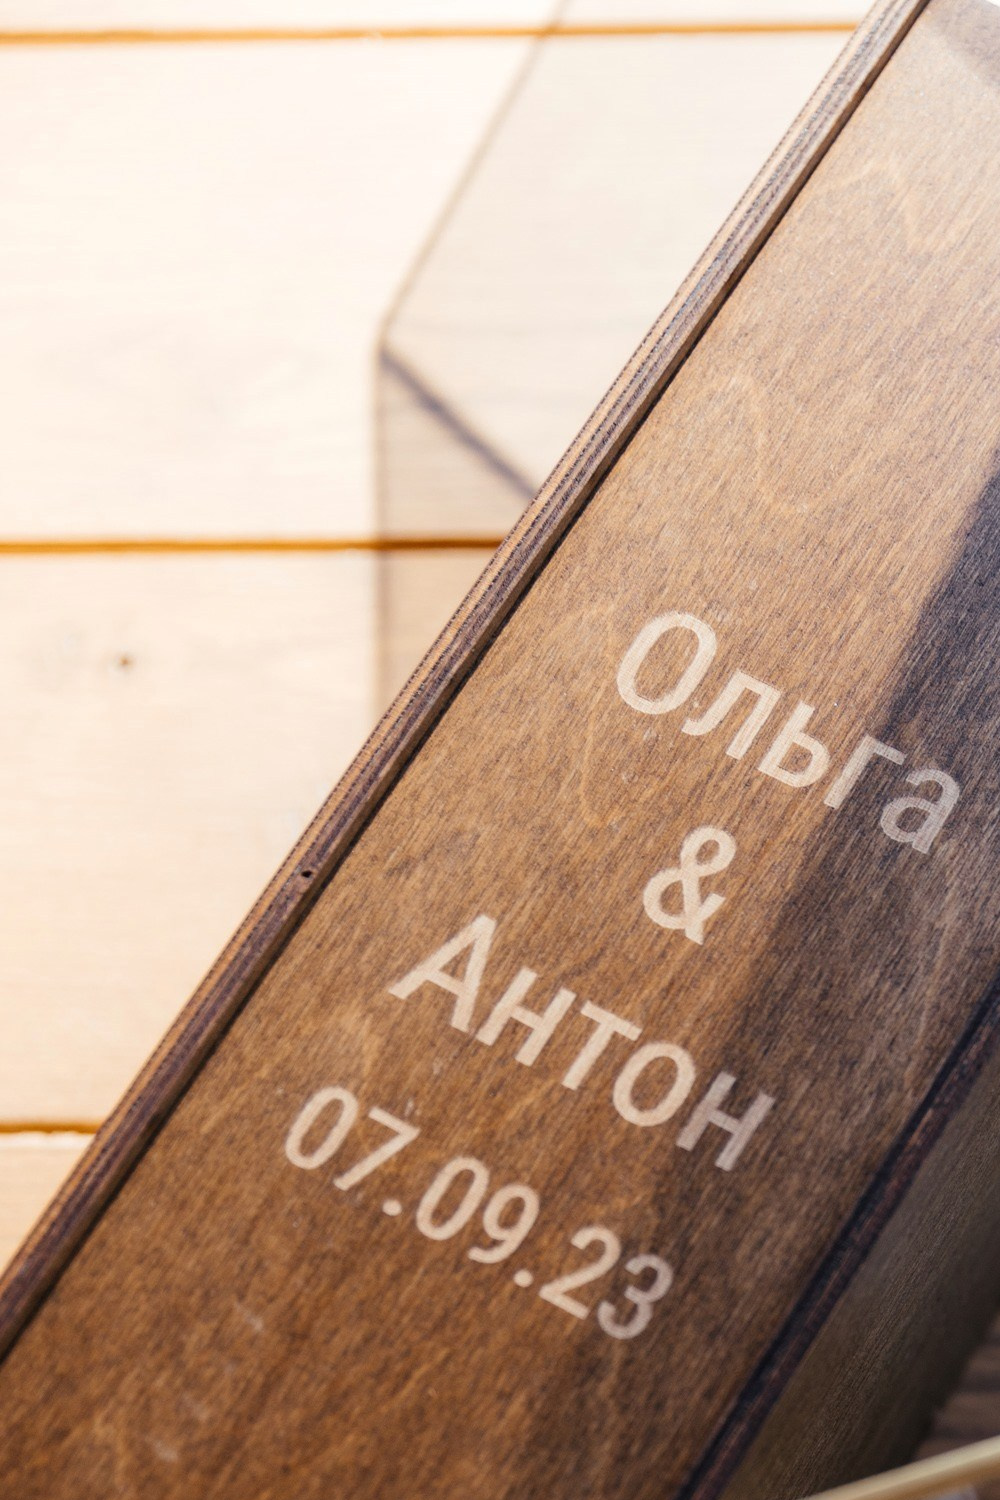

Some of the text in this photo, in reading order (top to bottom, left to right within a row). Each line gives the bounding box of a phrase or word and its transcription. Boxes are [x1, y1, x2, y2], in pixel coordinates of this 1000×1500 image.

[616, 611, 961, 855] Ольга
[642, 825, 738, 945] &
[388, 914, 775, 1173] Антон
[283, 1086, 674, 1341] 07.09.23
